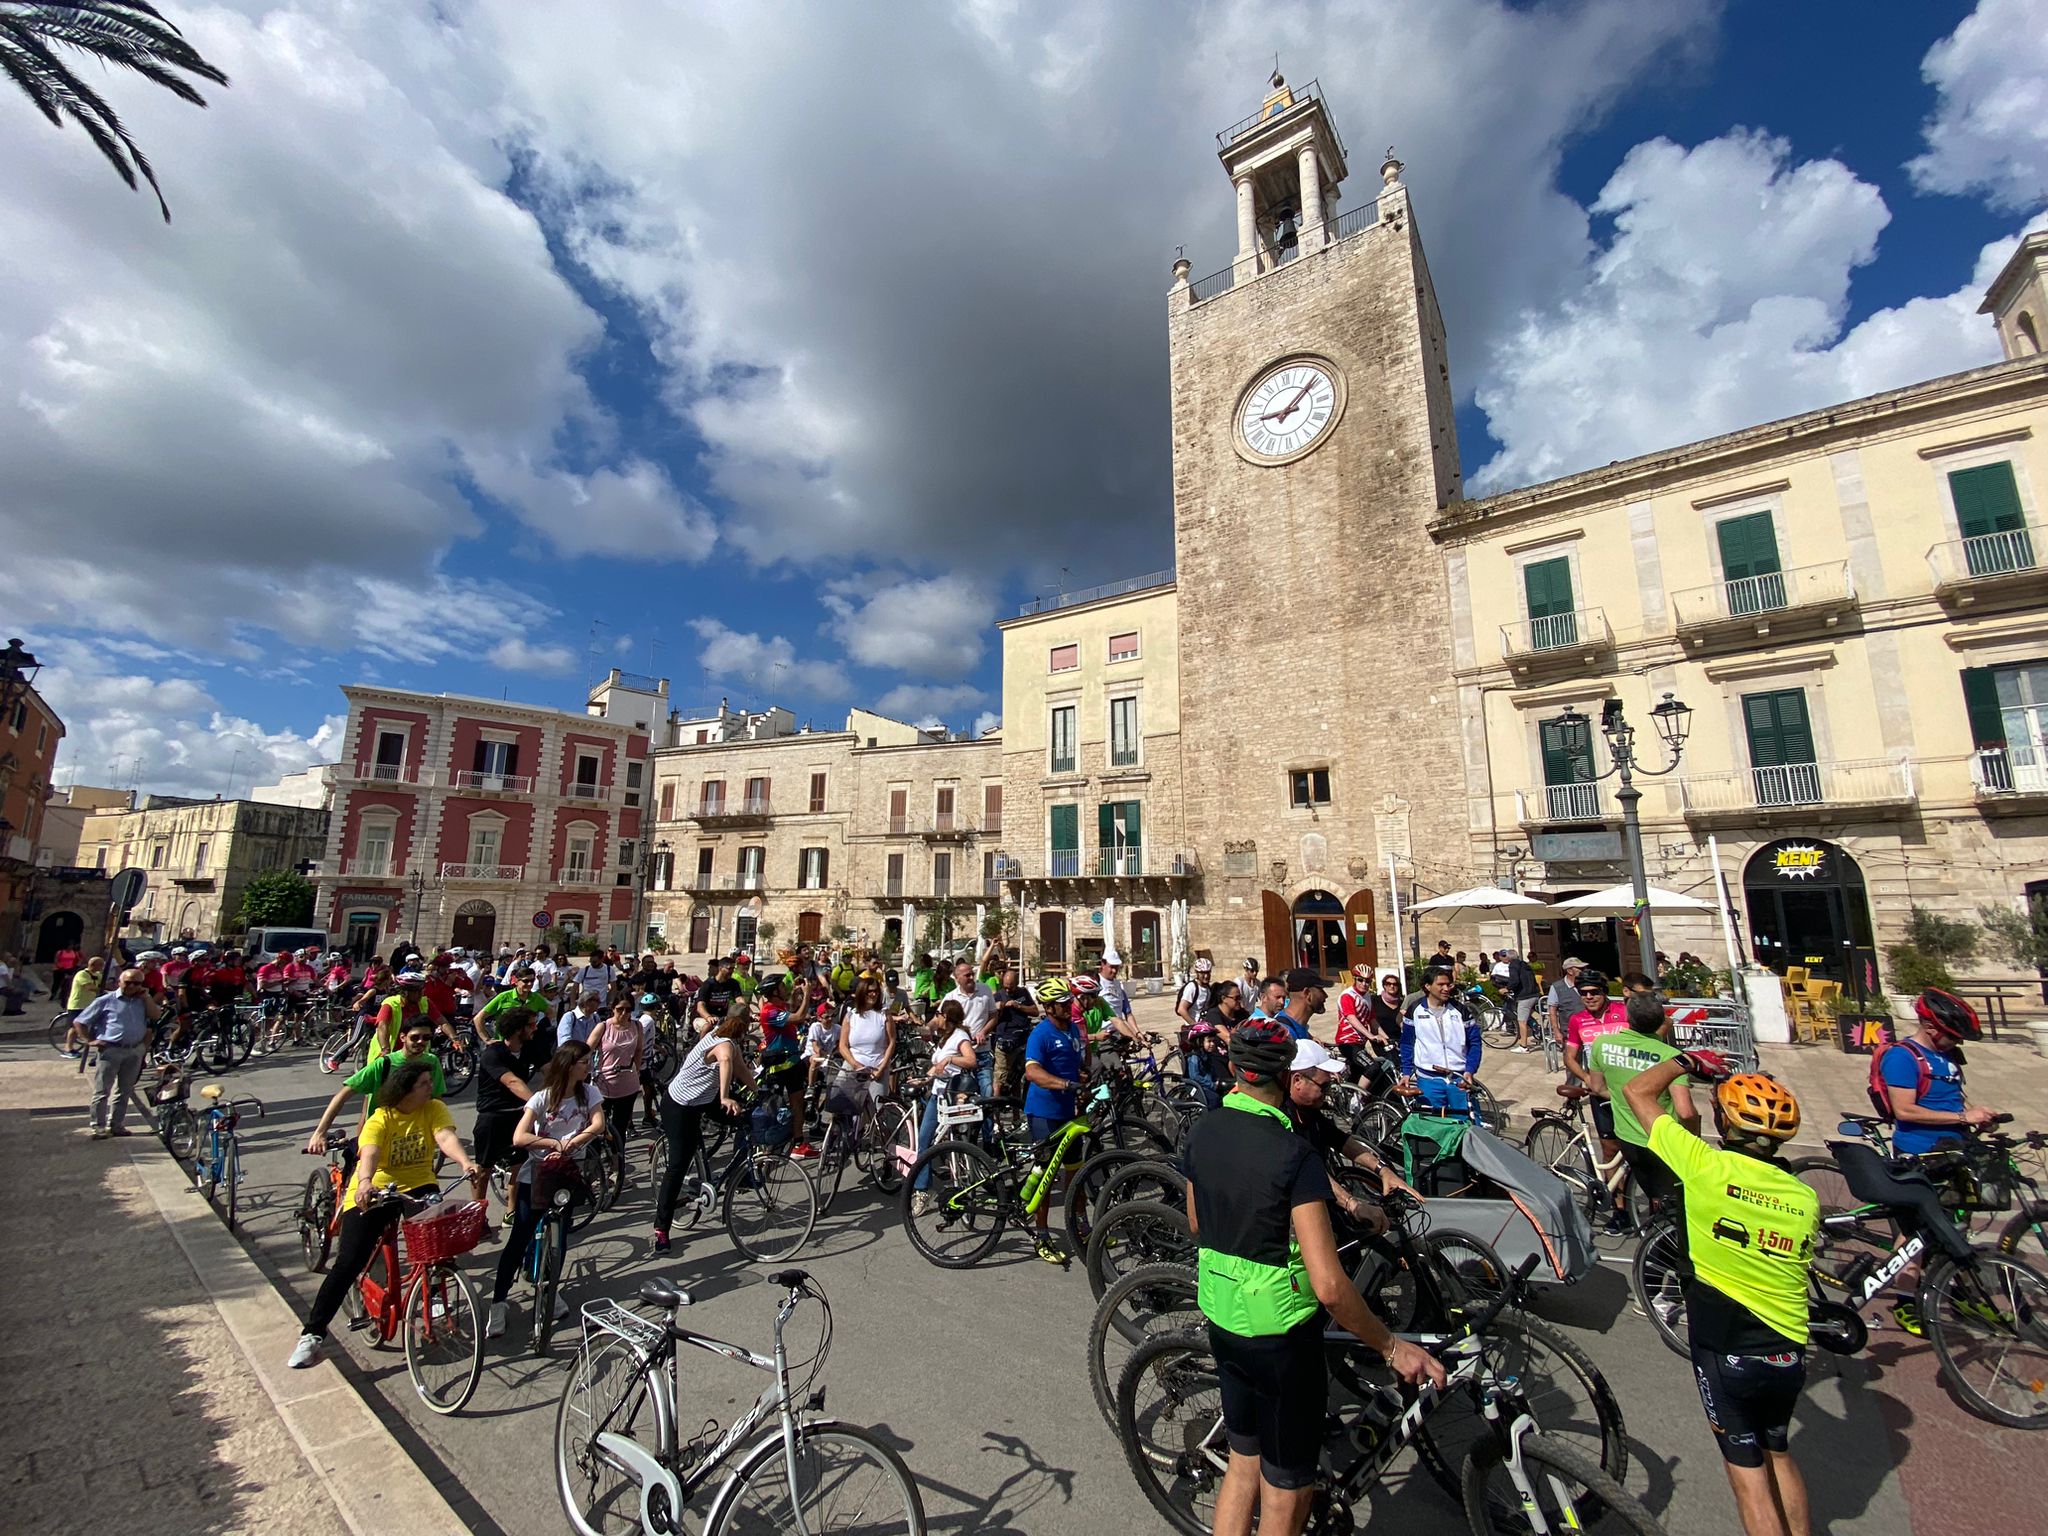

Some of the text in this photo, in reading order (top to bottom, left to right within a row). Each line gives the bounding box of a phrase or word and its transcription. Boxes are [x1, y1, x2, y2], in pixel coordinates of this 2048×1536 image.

[1776, 850, 1824, 867] KENT
[341, 893, 394, 902] FARMACIA
[1862, 1020, 1884, 1045] K
[1601, 1043, 1661, 1062] PULIAMO
[1601, 1052, 1657, 1072] TERLIZZ
[1742, 1187, 1780, 1205] nuova
[1757, 1227, 1794, 1253] 1,5m
[1863, 1237, 1925, 1301] Atala
